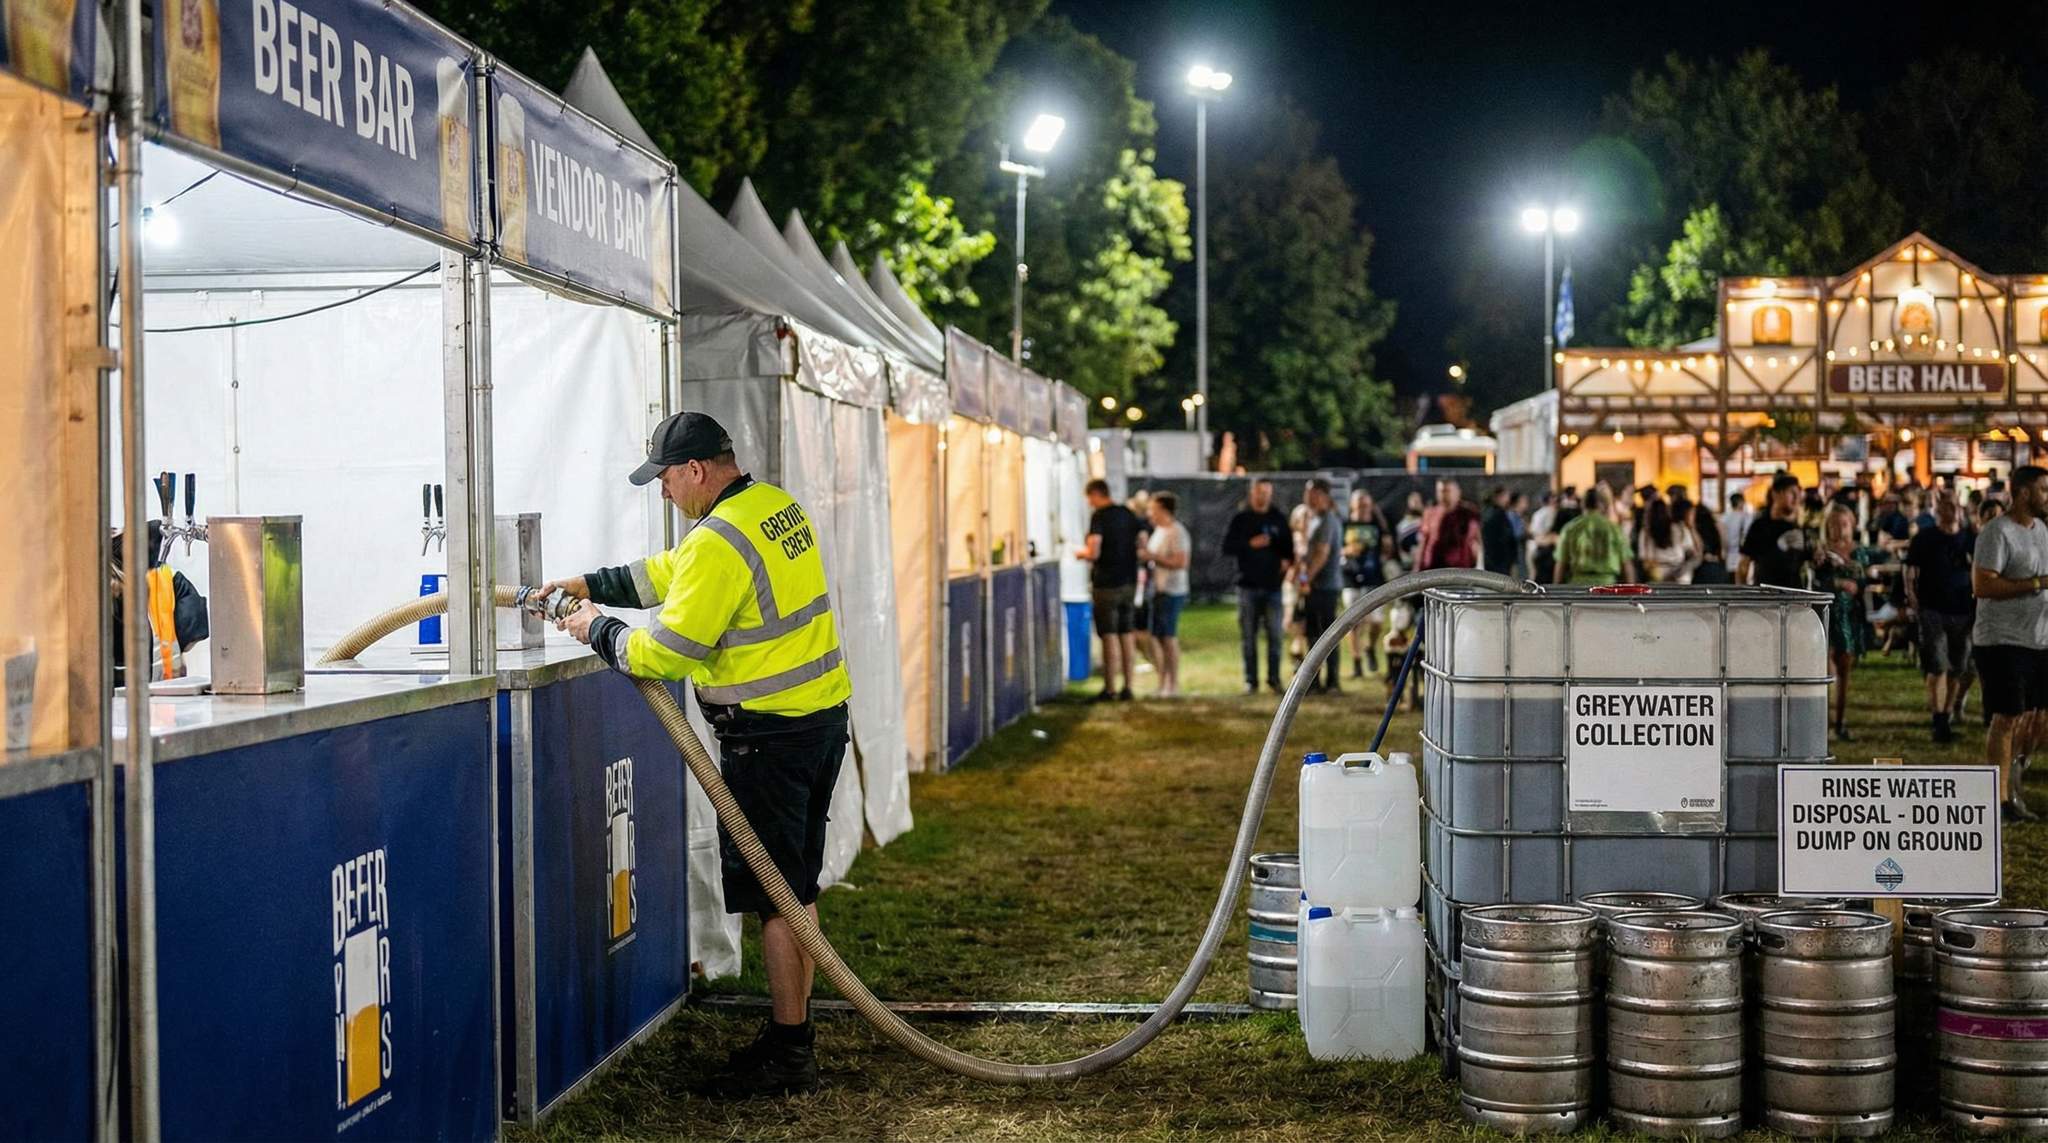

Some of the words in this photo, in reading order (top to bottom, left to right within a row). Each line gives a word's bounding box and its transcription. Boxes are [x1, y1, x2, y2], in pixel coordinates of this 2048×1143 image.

[252, 0, 345, 128] BEER
[353, 40, 417, 161] BAR
[530, 139, 609, 245] VENDOR
[611, 179, 647, 262] BAR
[1848, 364, 1914, 393] BEER
[1921, 364, 1987, 393] HALL
[781, 525, 814, 560] CREW
[1575, 693, 1715, 717] GREYWATER
[1575, 723, 1715, 746] COLLECTION
[1821, 778, 1881, 799] RINSE
[1887, 778, 1957, 799] WATER
[1792, 804, 1892, 825] DISPOSAL
[1911, 804, 1940, 825] DO
[1946, 804, 1987, 825] NOT
[1796, 830, 1857, 851] DUMP
[1862, 830, 1890, 851] ON
[1897, 830, 1983, 851] GROUND
